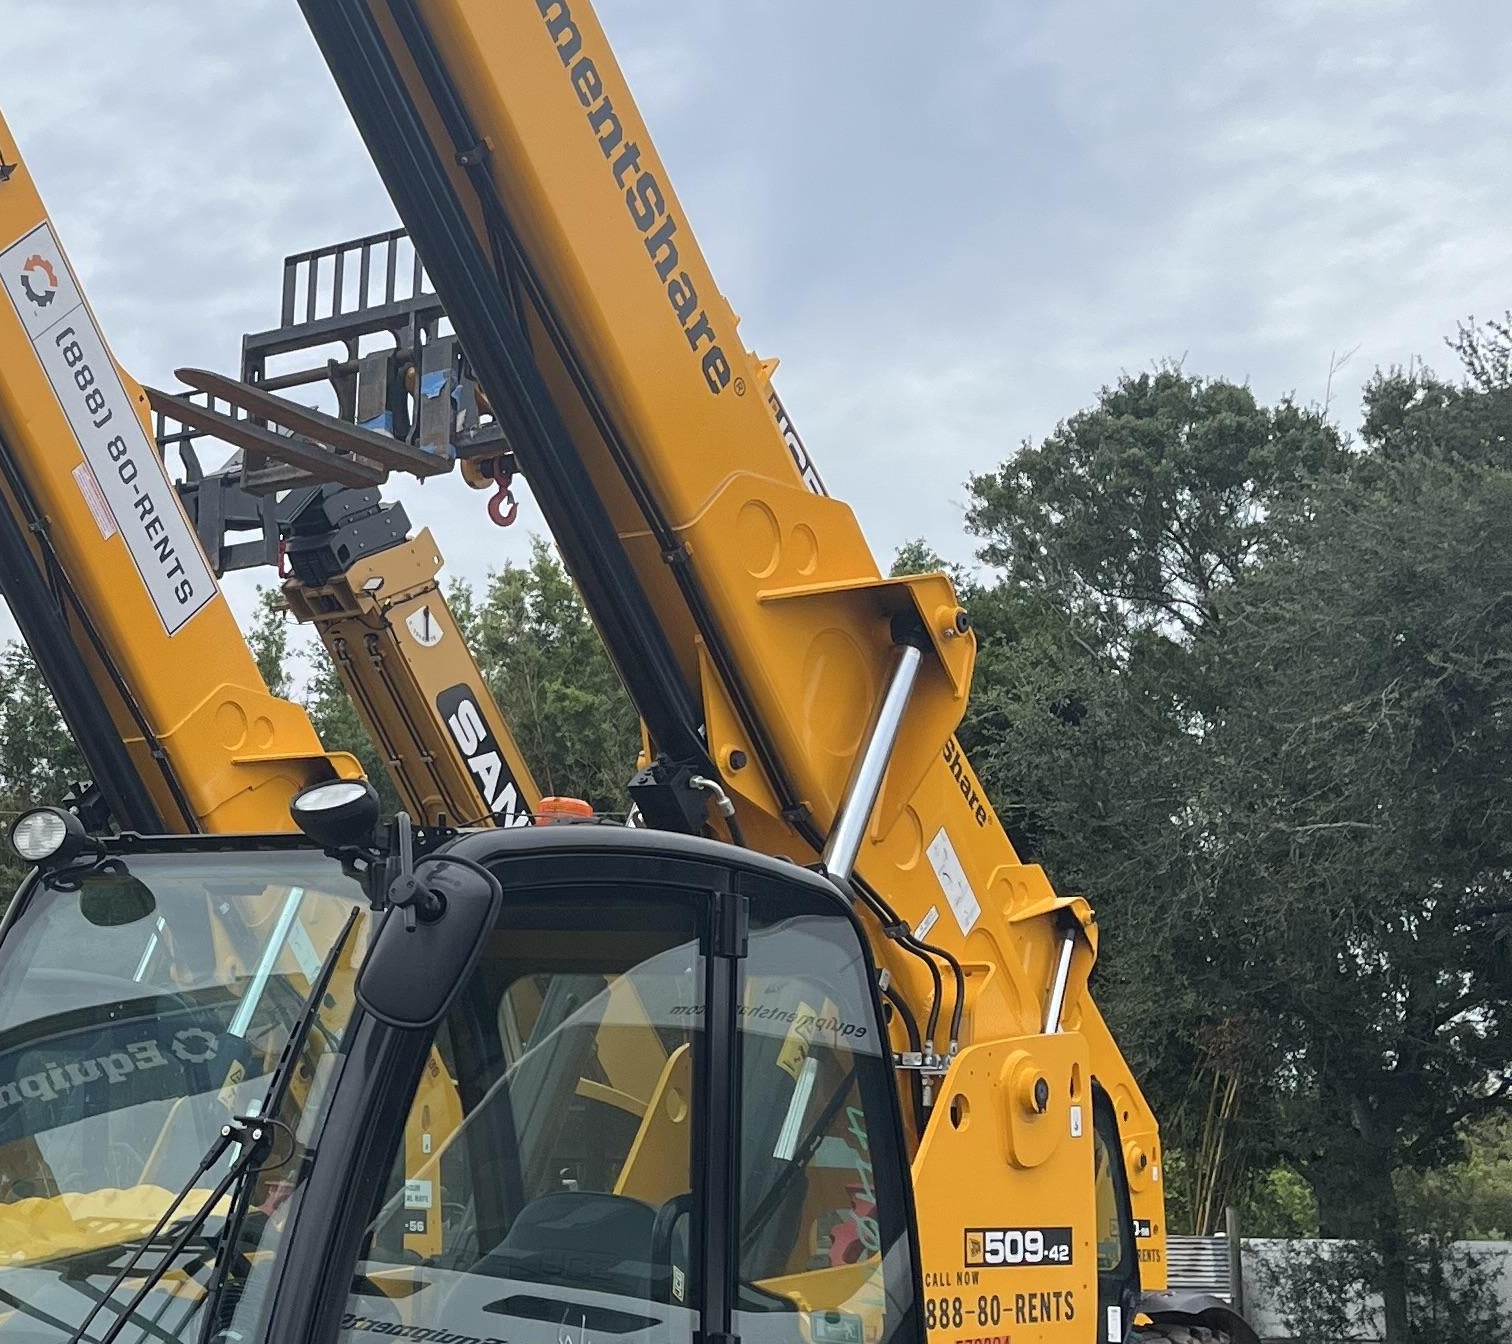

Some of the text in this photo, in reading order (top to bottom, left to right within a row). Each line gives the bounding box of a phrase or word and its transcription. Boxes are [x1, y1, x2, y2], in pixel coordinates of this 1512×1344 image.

[55, 326, 114, 430] (888)
[106, 433, 194, 607] 80-RENTS
[925, 1271, 980, 1288] CALL NOW
